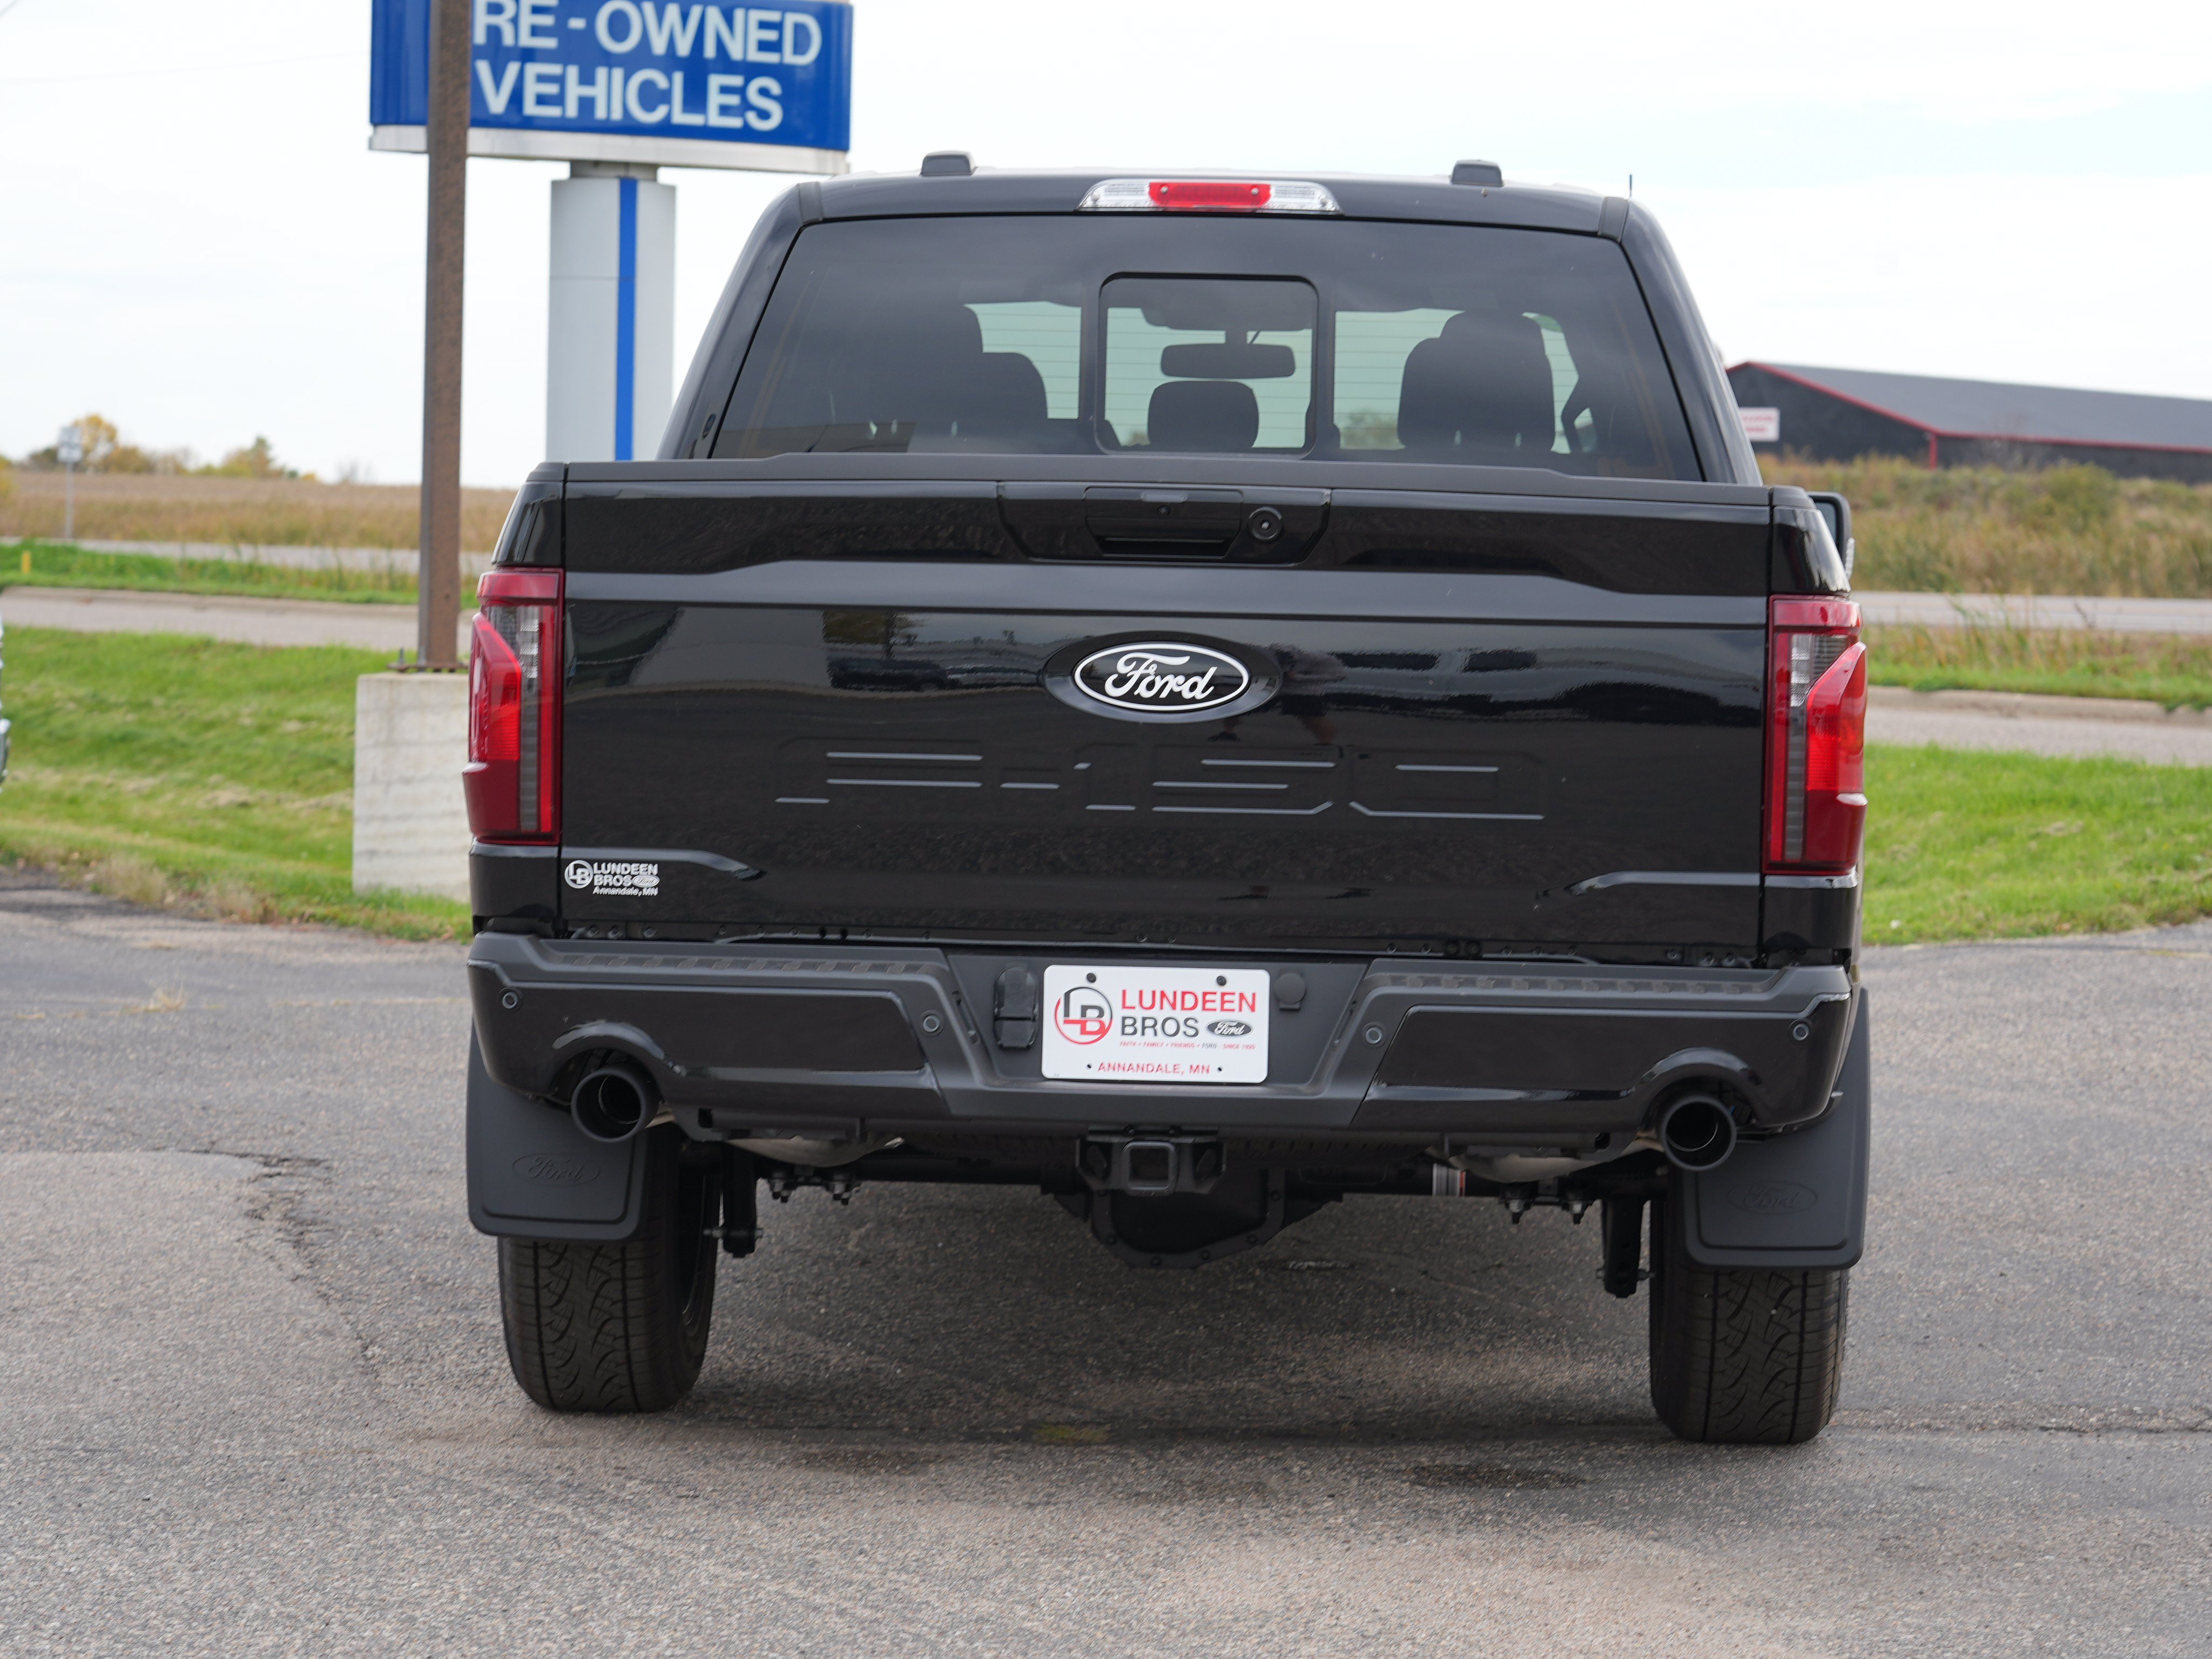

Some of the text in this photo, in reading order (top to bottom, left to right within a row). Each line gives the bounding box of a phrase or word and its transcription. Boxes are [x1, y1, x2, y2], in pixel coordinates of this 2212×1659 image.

[473, 0, 822, 65] RE-OWNED
[475, 59, 783, 131] VEHICLES
[1105, 652, 1218, 700] Ford
[594, 862, 658, 875] LUNDEEN
[593, 886, 658, 896] Annandale, MN
[594, 874, 632, 887] BROS
[1121, 989, 1257, 1013] LUNDEEN
[1121, 1016, 1199, 1037] BROS
[1097, 1062, 1210, 1075] ANNANDALE, MN
